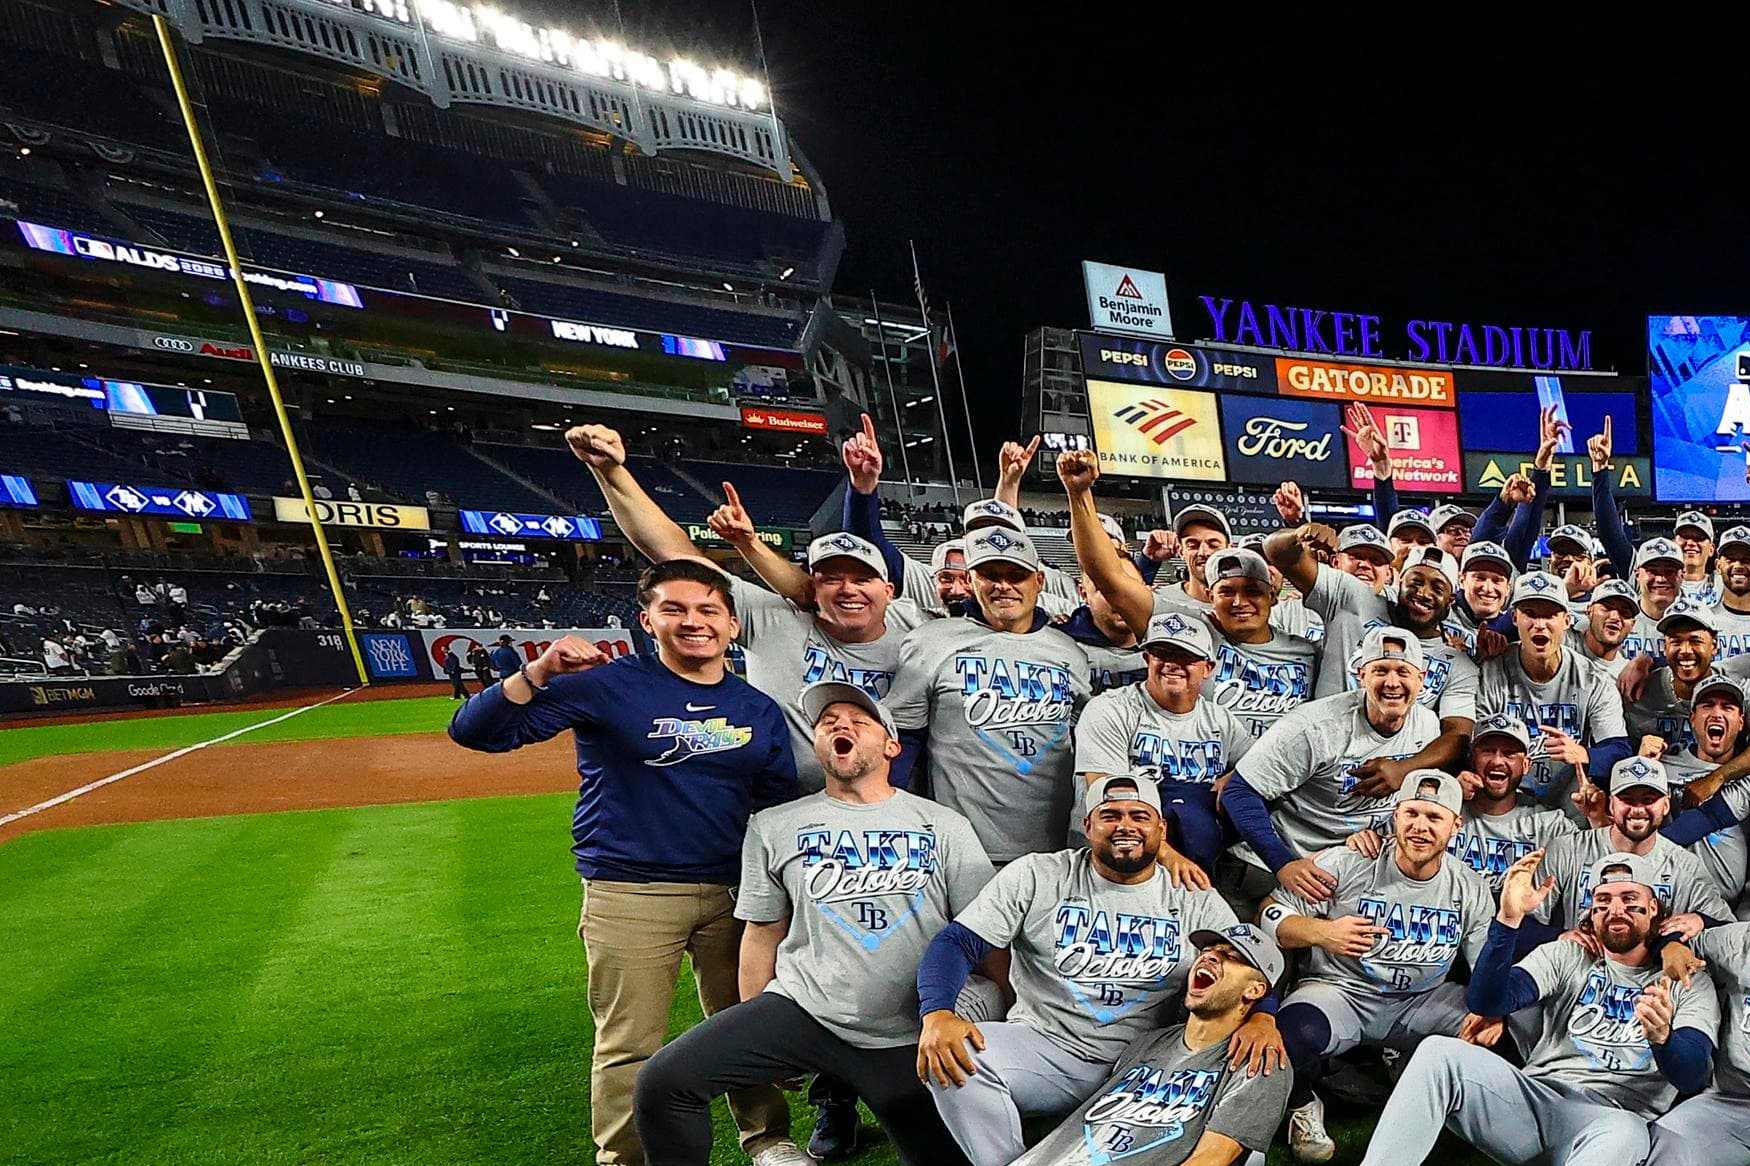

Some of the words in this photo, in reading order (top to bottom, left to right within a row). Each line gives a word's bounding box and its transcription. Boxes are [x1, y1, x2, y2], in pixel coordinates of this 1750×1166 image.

[115, 246, 181, 272] ALDS
[1098, 296, 1162, 321] Benjamin
[1109, 311, 1153, 328] Moore
[551, 320, 589, 341] NEW
[589, 324, 640, 350] YORK
[1198, 295, 1383, 358] YANKEE
[1407, 320, 1593, 371] STADIUM
[200, 342, 254, 362] Audi
[271, 352, 327, 371] ANKEES
[329, 361, 365, 376] CLUB
[1100, 349, 1149, 367] PEPSI
[1166, 358, 1196, 371] PEPSI
[1212, 363, 1258, 379] PEPSI
[1287, 366, 1448, 401] GATORADE
[767, 415, 825, 430] Budweiser
[1237, 416, 1333, 462] Ford
[1100, 452, 1137, 464] BANK
[1141, 455, 1159, 466] OF
[1161, 456, 1221, 470] AMERICA
[1365, 456, 1445, 470] Aerica's
[1391, 468, 1458, 483] Network
[688, 525, 725, 541] Pola
[756, 529, 784, 546] ring
[317, 635, 343, 647] 318
[370, 639, 402, 653] NEW
[369, 648, 410, 662] YORK
[378, 660, 409, 672] LIFE
[955, 656, 1072, 702] TAKE
[1215, 644, 1308, 699] TAKE
[47, 686, 95, 703] BETMGM
[963, 689, 1074, 730] October
[1506, 701, 1582, 739] TAKE
[647, 717, 738, 739] DEVIL
[688, 726, 753, 752] RAYS
[1005, 730, 1038, 757] TB
[1134, 732, 1226, 778] TAKE
[798, 830, 936, 874] TAKE
[803, 857, 931, 901] October
[850, 902, 889, 930] TB
[1358, 898, 1462, 947] TAKE
[1055, 905, 1181, 963] TAKE
[1054, 941, 1180, 979] October
[1387, 966, 1412, 991] TB
[1093, 982, 1125, 1007] TB
[1578, 970, 1645, 1026] TAK
[1103, 1064, 1222, 1112] TAKE
[1107, 1124, 1136, 1153] TB
